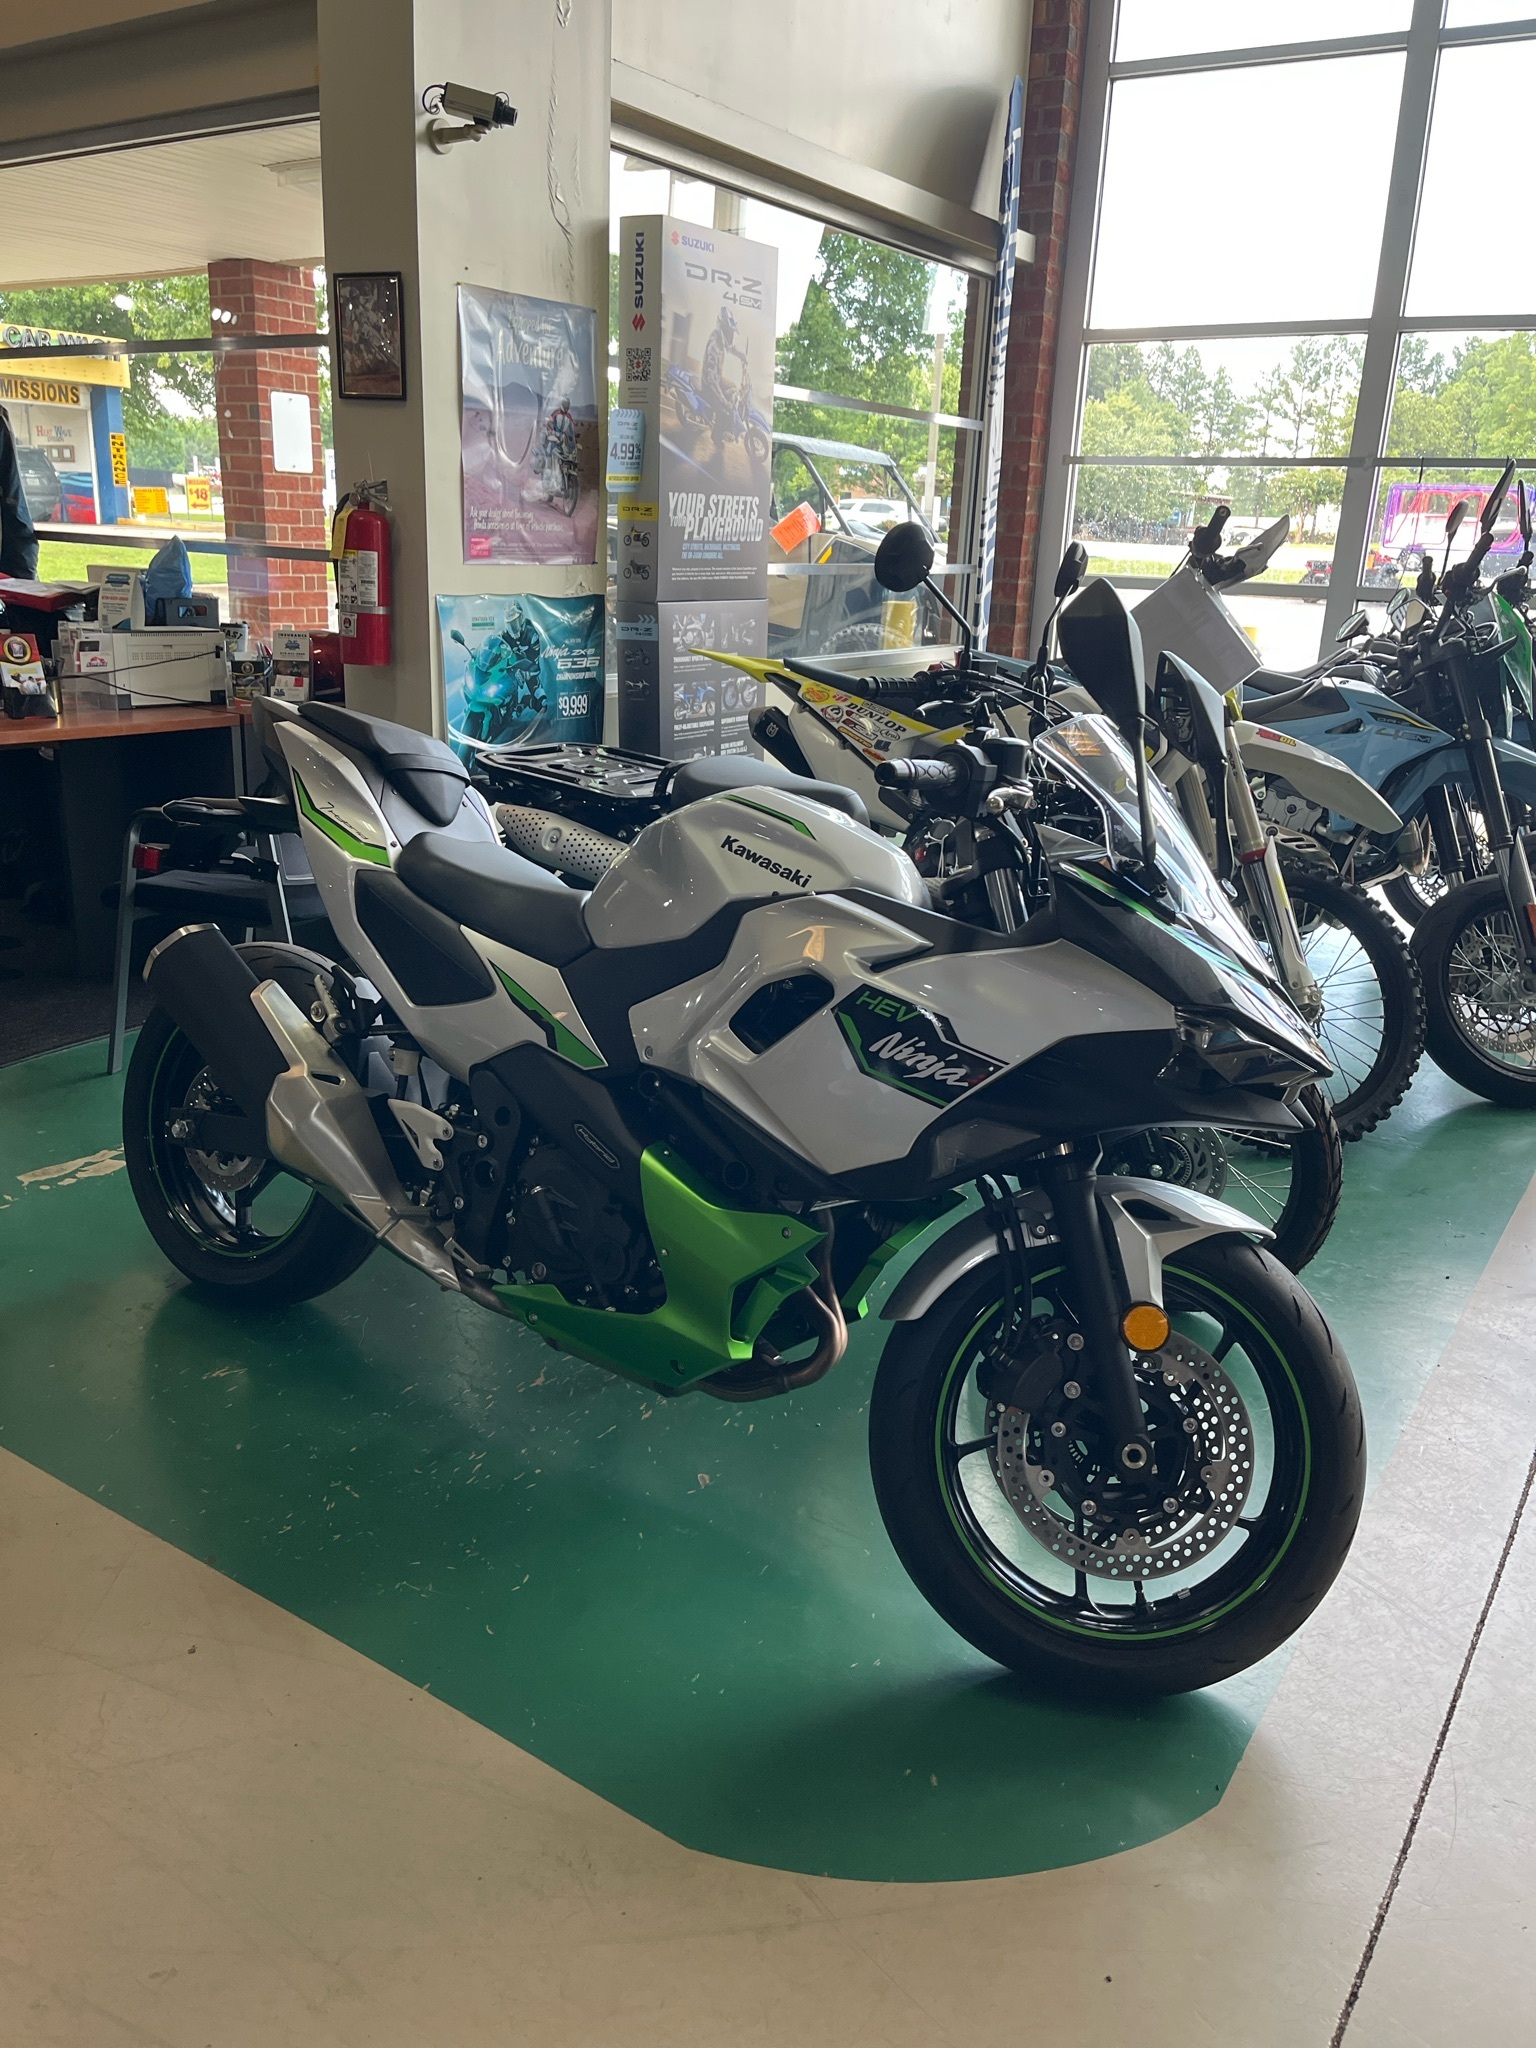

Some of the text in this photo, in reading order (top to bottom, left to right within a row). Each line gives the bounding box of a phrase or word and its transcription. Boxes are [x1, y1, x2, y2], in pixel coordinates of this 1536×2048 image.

[681, 235, 715, 253] SUZUKI
[634, 232, 645, 309] SUZUKI
[684, 262, 763, 295] DR-Z
[3, 326, 52, 348] CAR
[497, 332, 565, 369] Adventure
[0, 379, 80, 404] MISSIONS
[189, 488, 208, 501] $18
[668, 492, 760, 520] YOUR STREETS
[670, 516, 686, 527] YOUR
[684, 516, 764, 542] PLAYGROUND
[541, 644, 570, 661] Ninja
[557, 656, 601, 670] 636
[845, 702, 907, 735] DUNLOP
[720, 835, 812, 888] Kawasaki
[855, 991, 921, 1023] HEV
[868, 1032, 969, 1087] Ninja
[578, 1128, 616, 1164] Hybrid
